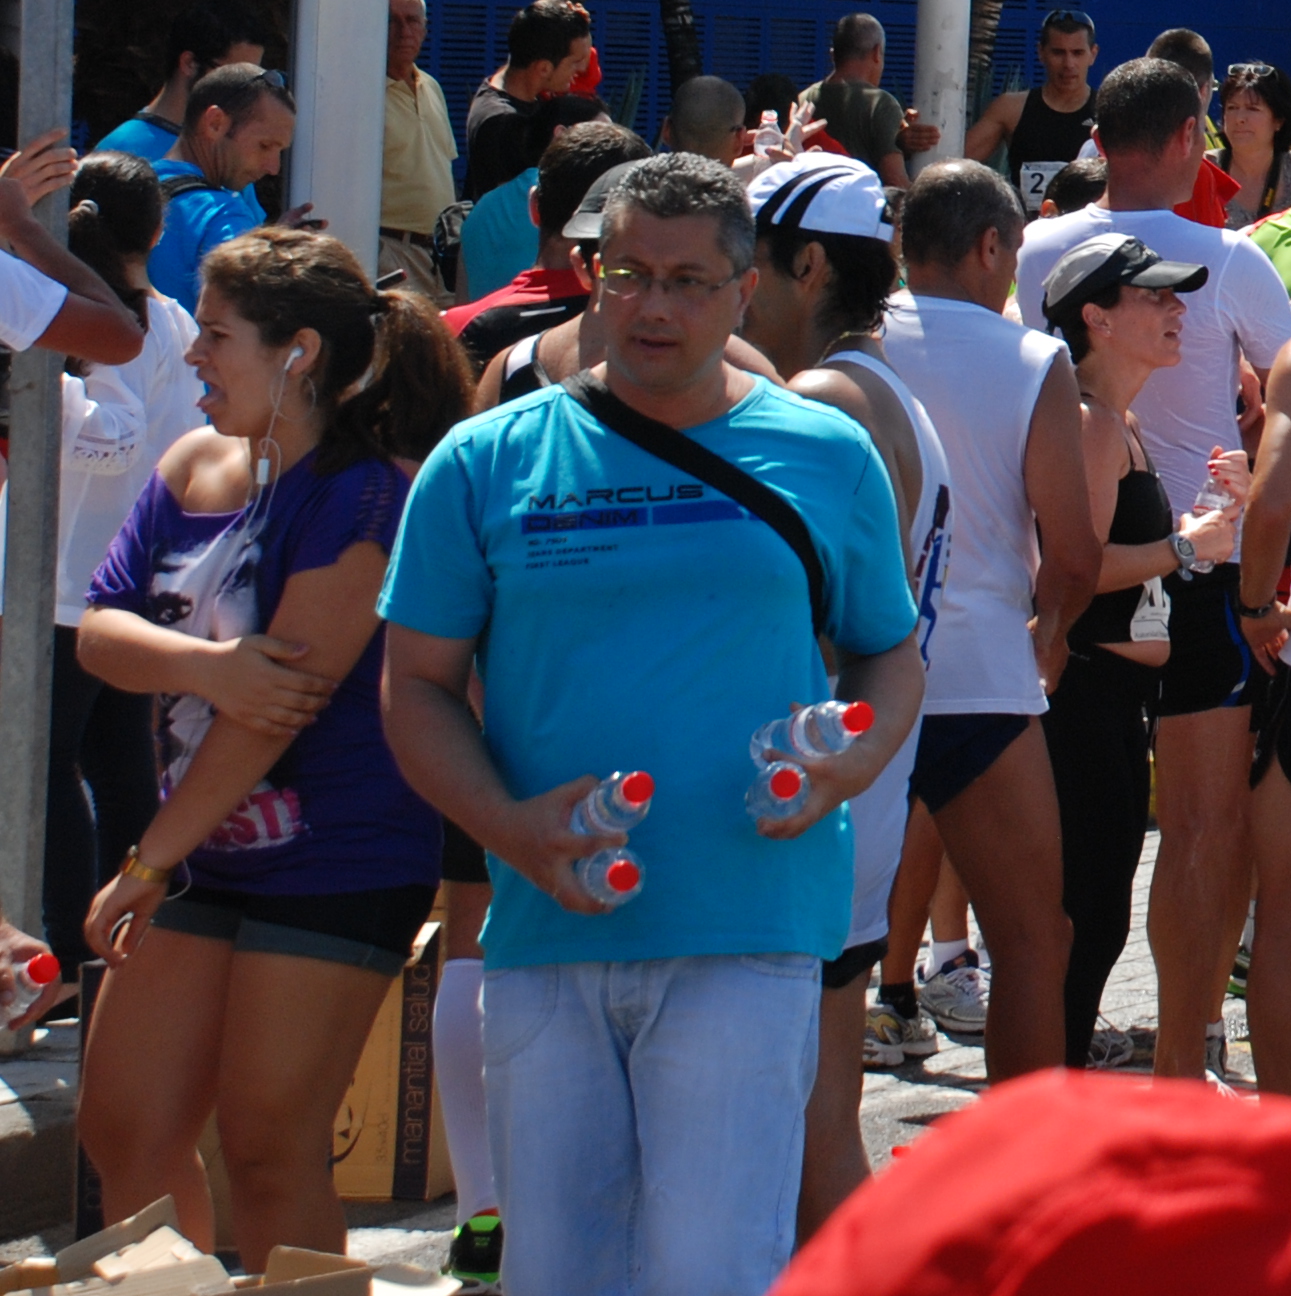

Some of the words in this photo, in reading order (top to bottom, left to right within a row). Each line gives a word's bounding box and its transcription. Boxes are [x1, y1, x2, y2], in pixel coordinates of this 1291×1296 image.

[528, 484, 704, 510] MARCUS
[527, 510, 639, 532] DENIM
[402, 1041, 428, 1164] manantial
